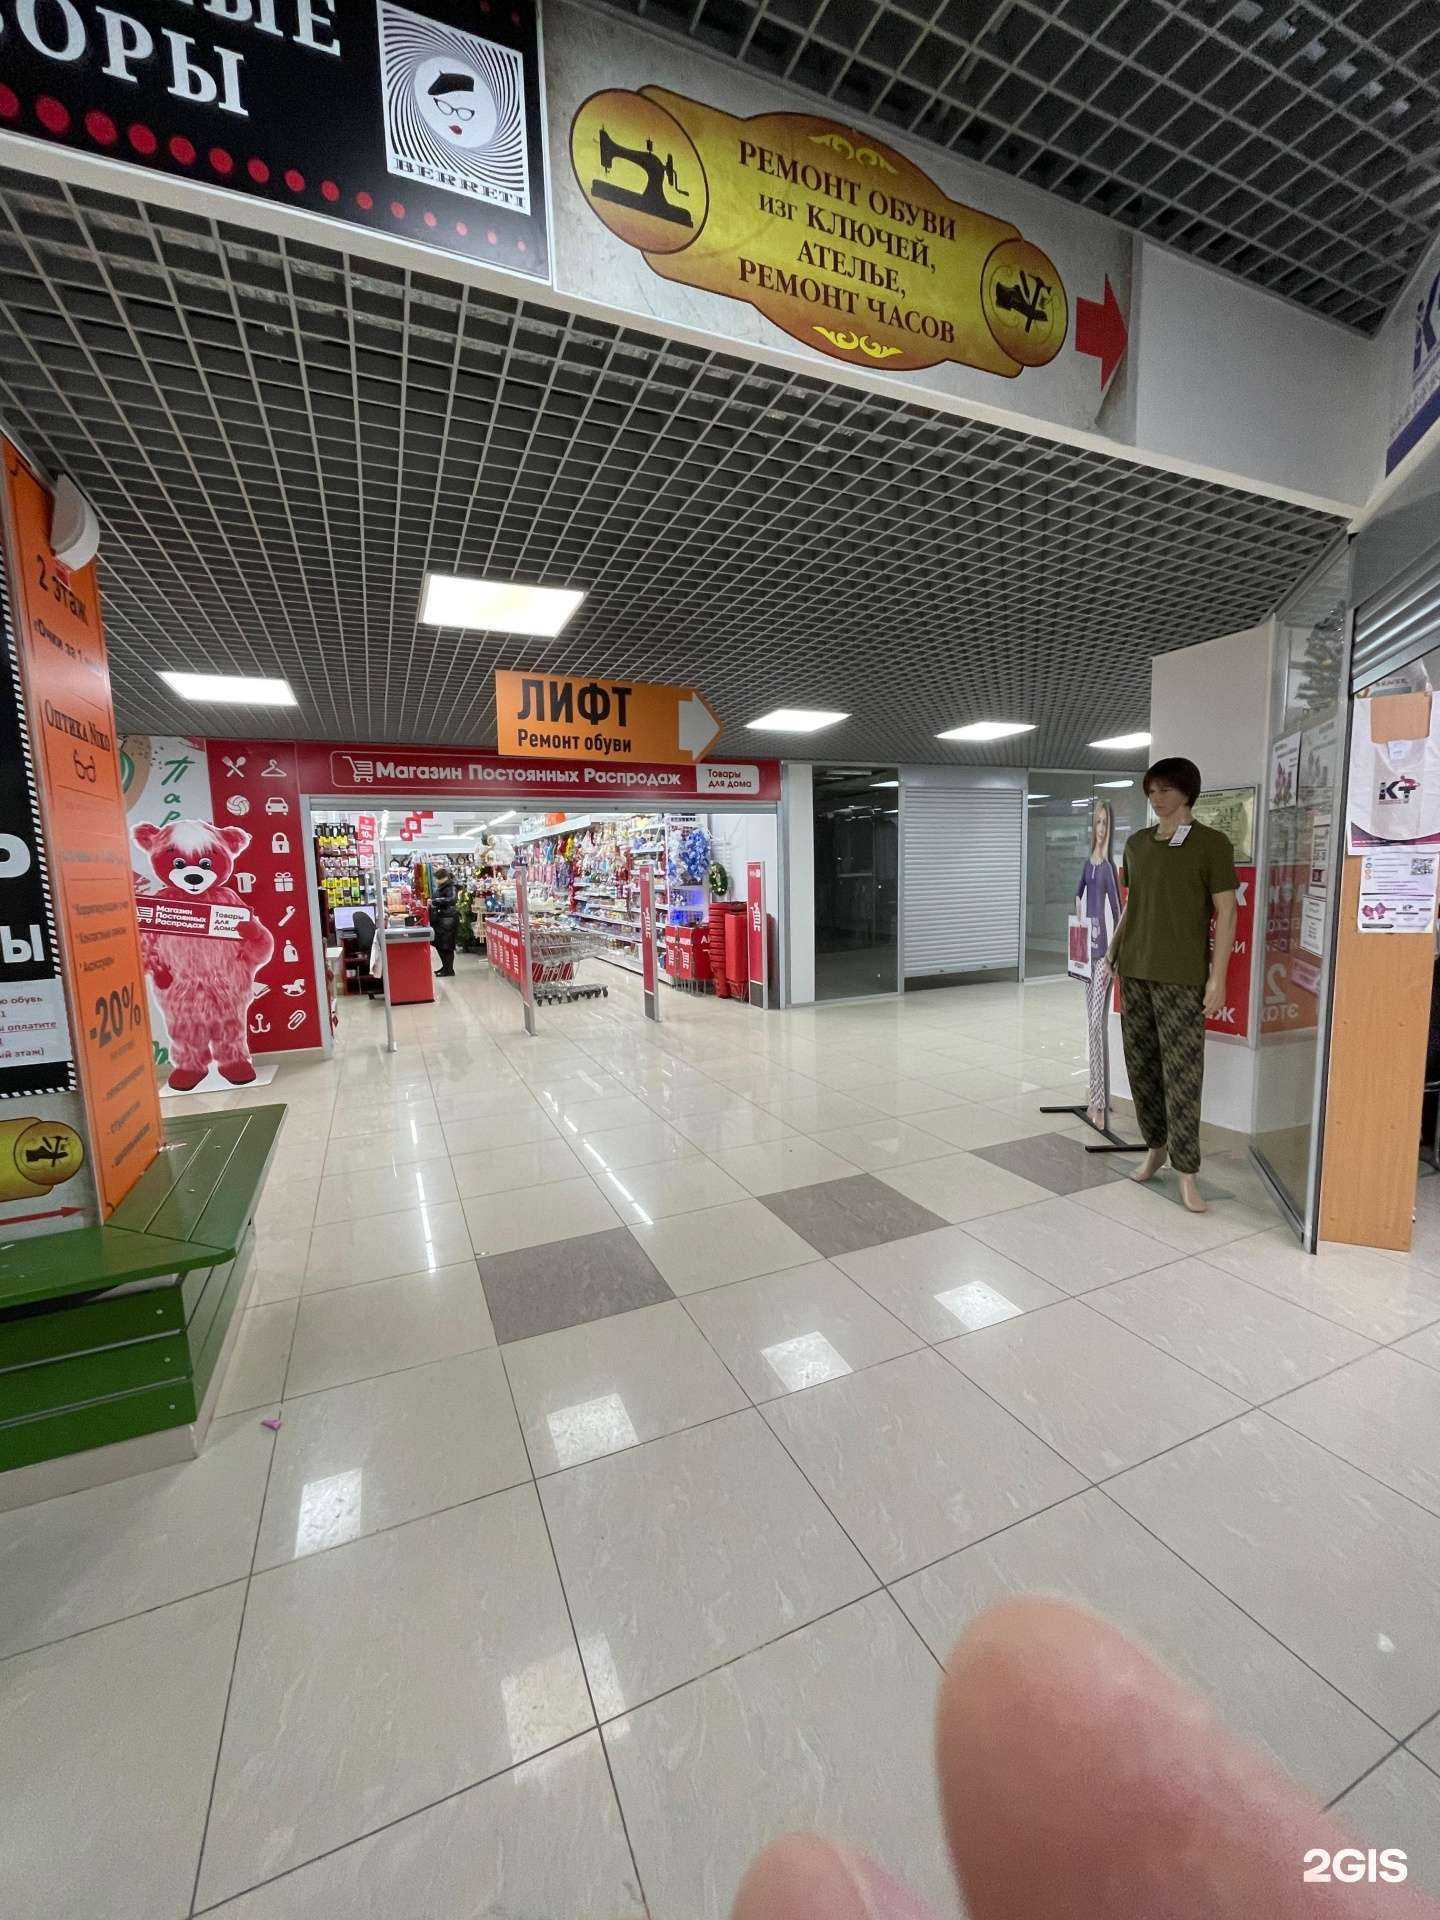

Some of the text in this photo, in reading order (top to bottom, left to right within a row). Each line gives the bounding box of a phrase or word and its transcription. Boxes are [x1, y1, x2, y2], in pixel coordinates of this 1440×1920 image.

[0, 0, 249, 116] ОРЫ
[738, 139, 956, 241] РЕМОНТ ОБУВИ
[806, 202, 936, 273] КЛЮЧЕЙ,
[797, 240, 906, 299] АТЕЛЬЕ,
[738, 256, 955, 344] РЕМОНТ ЧАСОВ
[517, 678, 632, 727] ЛИФТ
[518, 728, 632, 755] Ремонт обуви
[376, 761, 682, 787] Магазин Постоянных Распродаж
[708, 768, 742, 779] Товары
[708, 779, 752, 788] для дома
[156, 904, 193, 916] Магазин
[156, 912, 207, 924] Постоянных
[215, 911, 244, 920] Товары
[155, 918, 206, 930] Распродаж
[7, 1021, 57, 1032] оплатите
[89, 981, 142, 1048] -20%
